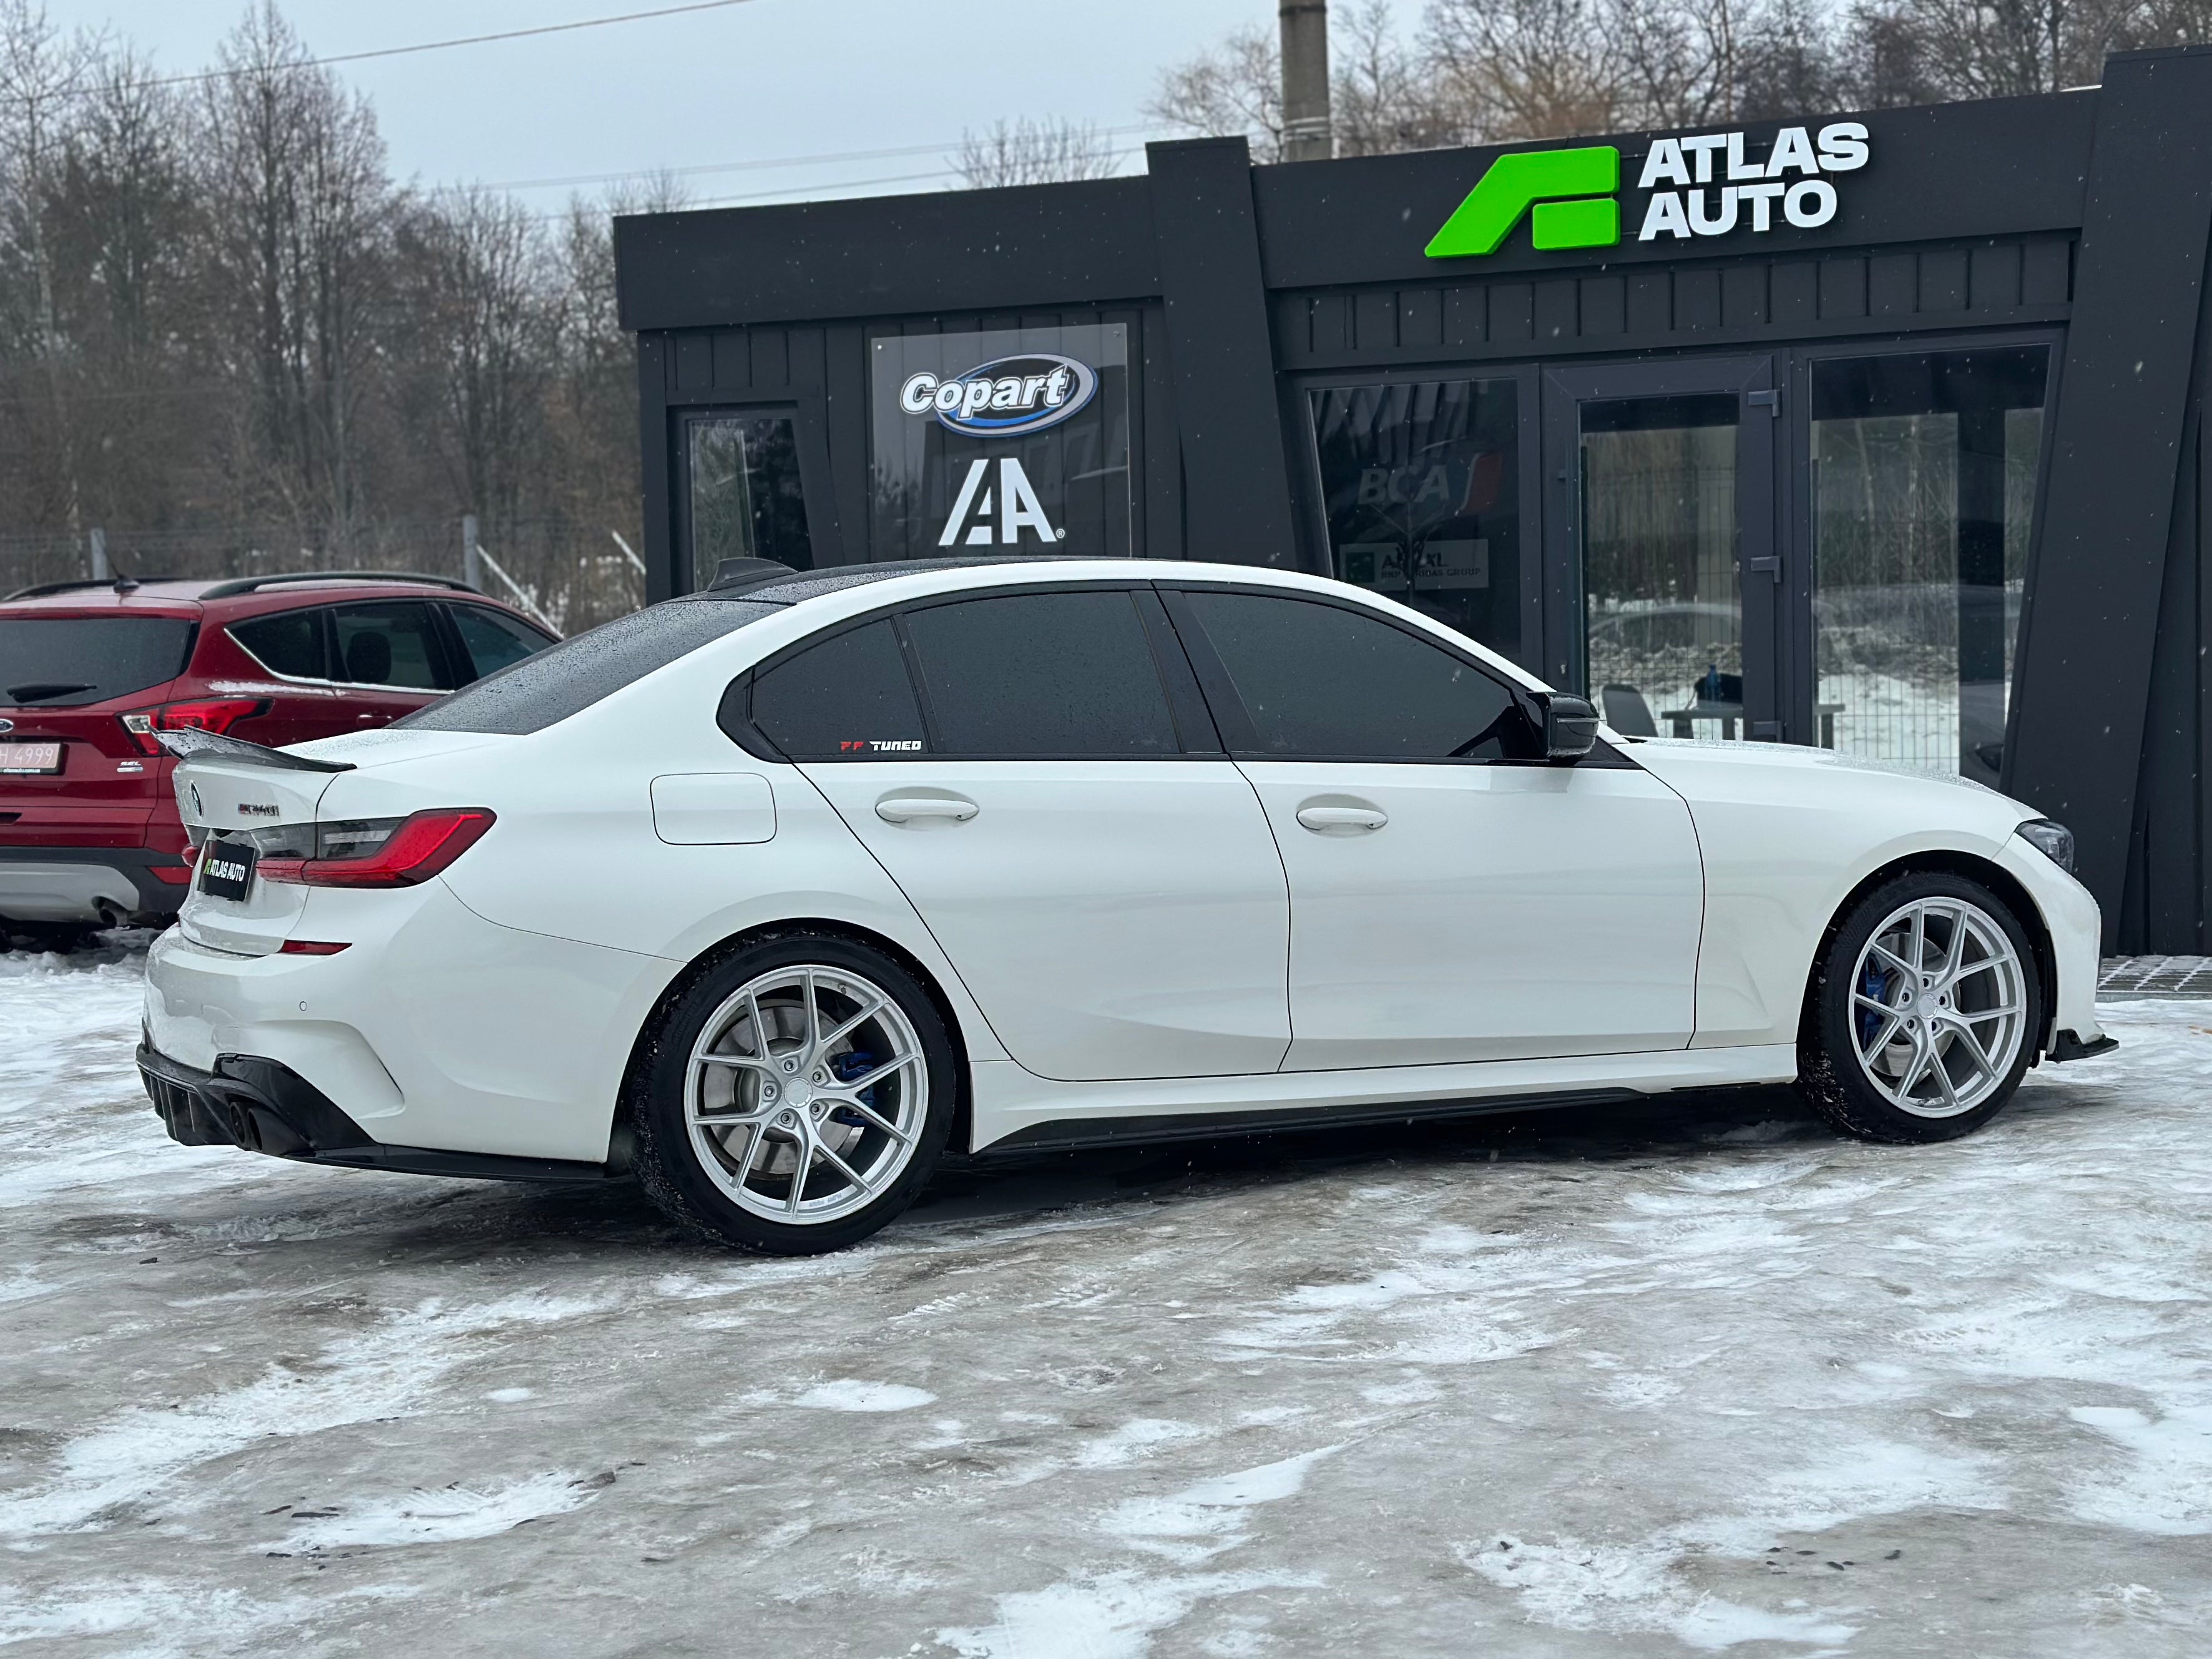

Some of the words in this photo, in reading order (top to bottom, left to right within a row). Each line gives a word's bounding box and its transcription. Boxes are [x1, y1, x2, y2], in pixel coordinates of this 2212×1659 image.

[1637, 122, 1869, 188] ATLAS
[1638, 179, 1838, 241] AUTO
[900, 364, 1069, 421] Copart
[1357, 465, 1451, 505] BCA
[1446, 567, 1481, 576] GROUP
[14, 748, 54, 765] 4999
[869, 740, 922, 751] TUNED
[210, 859, 229, 878] ATLAS
[227, 863, 245, 882] AUTO
